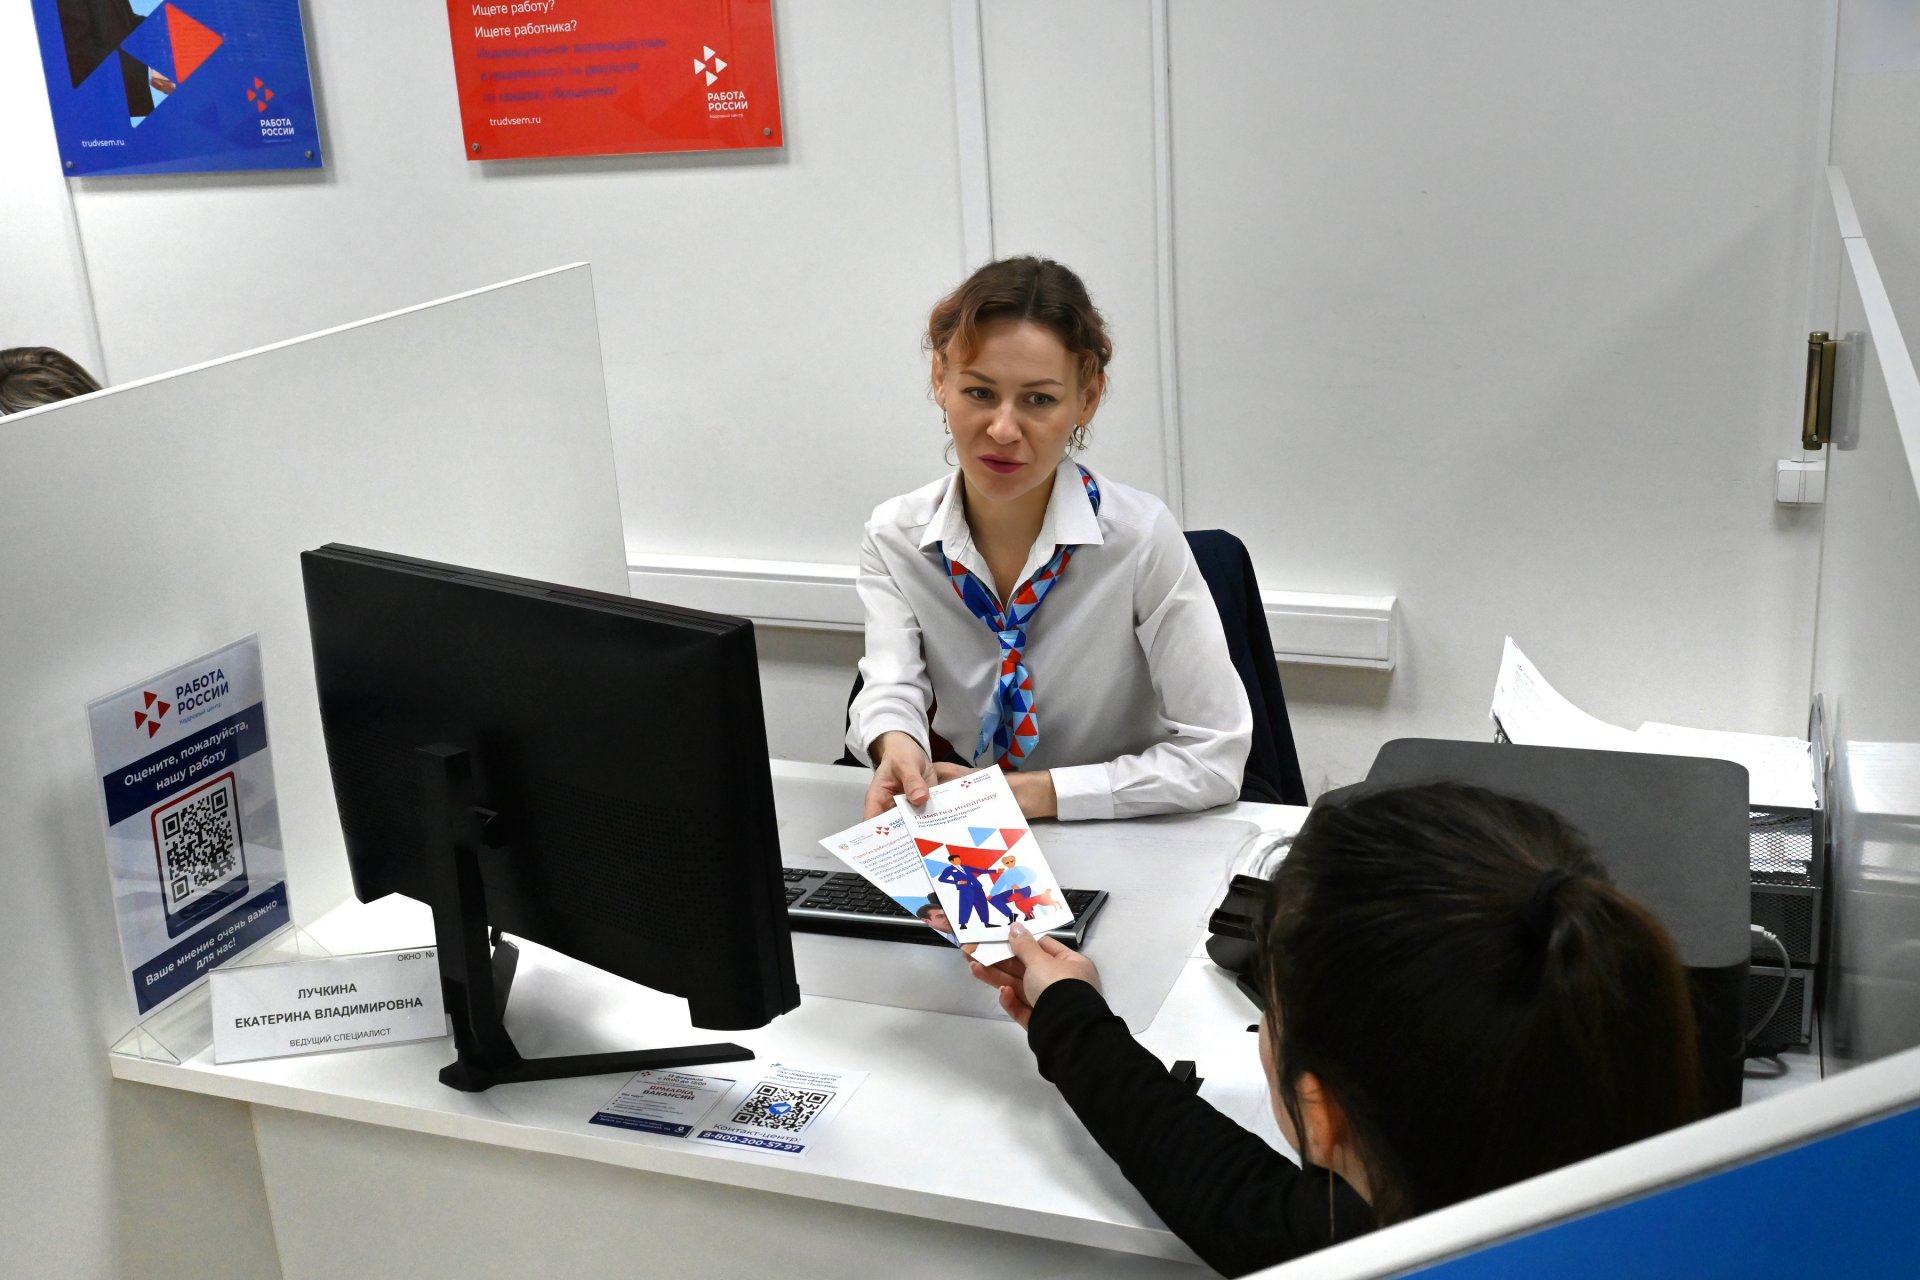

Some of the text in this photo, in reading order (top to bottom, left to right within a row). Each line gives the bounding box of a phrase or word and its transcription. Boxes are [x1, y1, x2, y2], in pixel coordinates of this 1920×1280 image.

[472, 0, 555, 17] Ищете работу?
[475, 19, 577, 39] Ищете работника?
[707, 91, 746, 101] РАБОТА
[708, 101, 748, 111] РОССИИ
[260, 118, 291, 127] РАБОТА
[489, 116, 541, 126] trudvsem.ru
[262, 127, 295, 136] РОССИИ
[81, 138, 125, 148] trudvsem.ru
[176, 668, 224, 700] РАБОТА
[177, 681, 229, 715] РОССИИ
[124, 720, 249, 786] Оцените, пожалуйста,
[156, 749, 226, 791] нашу работу
[914, 808, 953, 821] Памятка
[954, 793, 997, 812] инвалиду
[145, 899, 278, 986] Ваше мнение очень важно
[195, 937, 237, 972] для нас!
[397, 950, 435, 963] ОКНО №
[297, 982, 357, 1000] ЛУЧКИНА
[235, 996, 423, 1029] ЕКАТЕРИНА ВЛАДИМИРОВНА
[289, 1027, 391, 1048] ВЕДУЩИЙ СПЕЦИАЛИСТ
[649, 1085, 695, 1095] ЯРМАРКА
[703, 1132, 801, 1151] 8-800-200-57-97
[713, 1123, 801, 1143] Контакт-центр:
